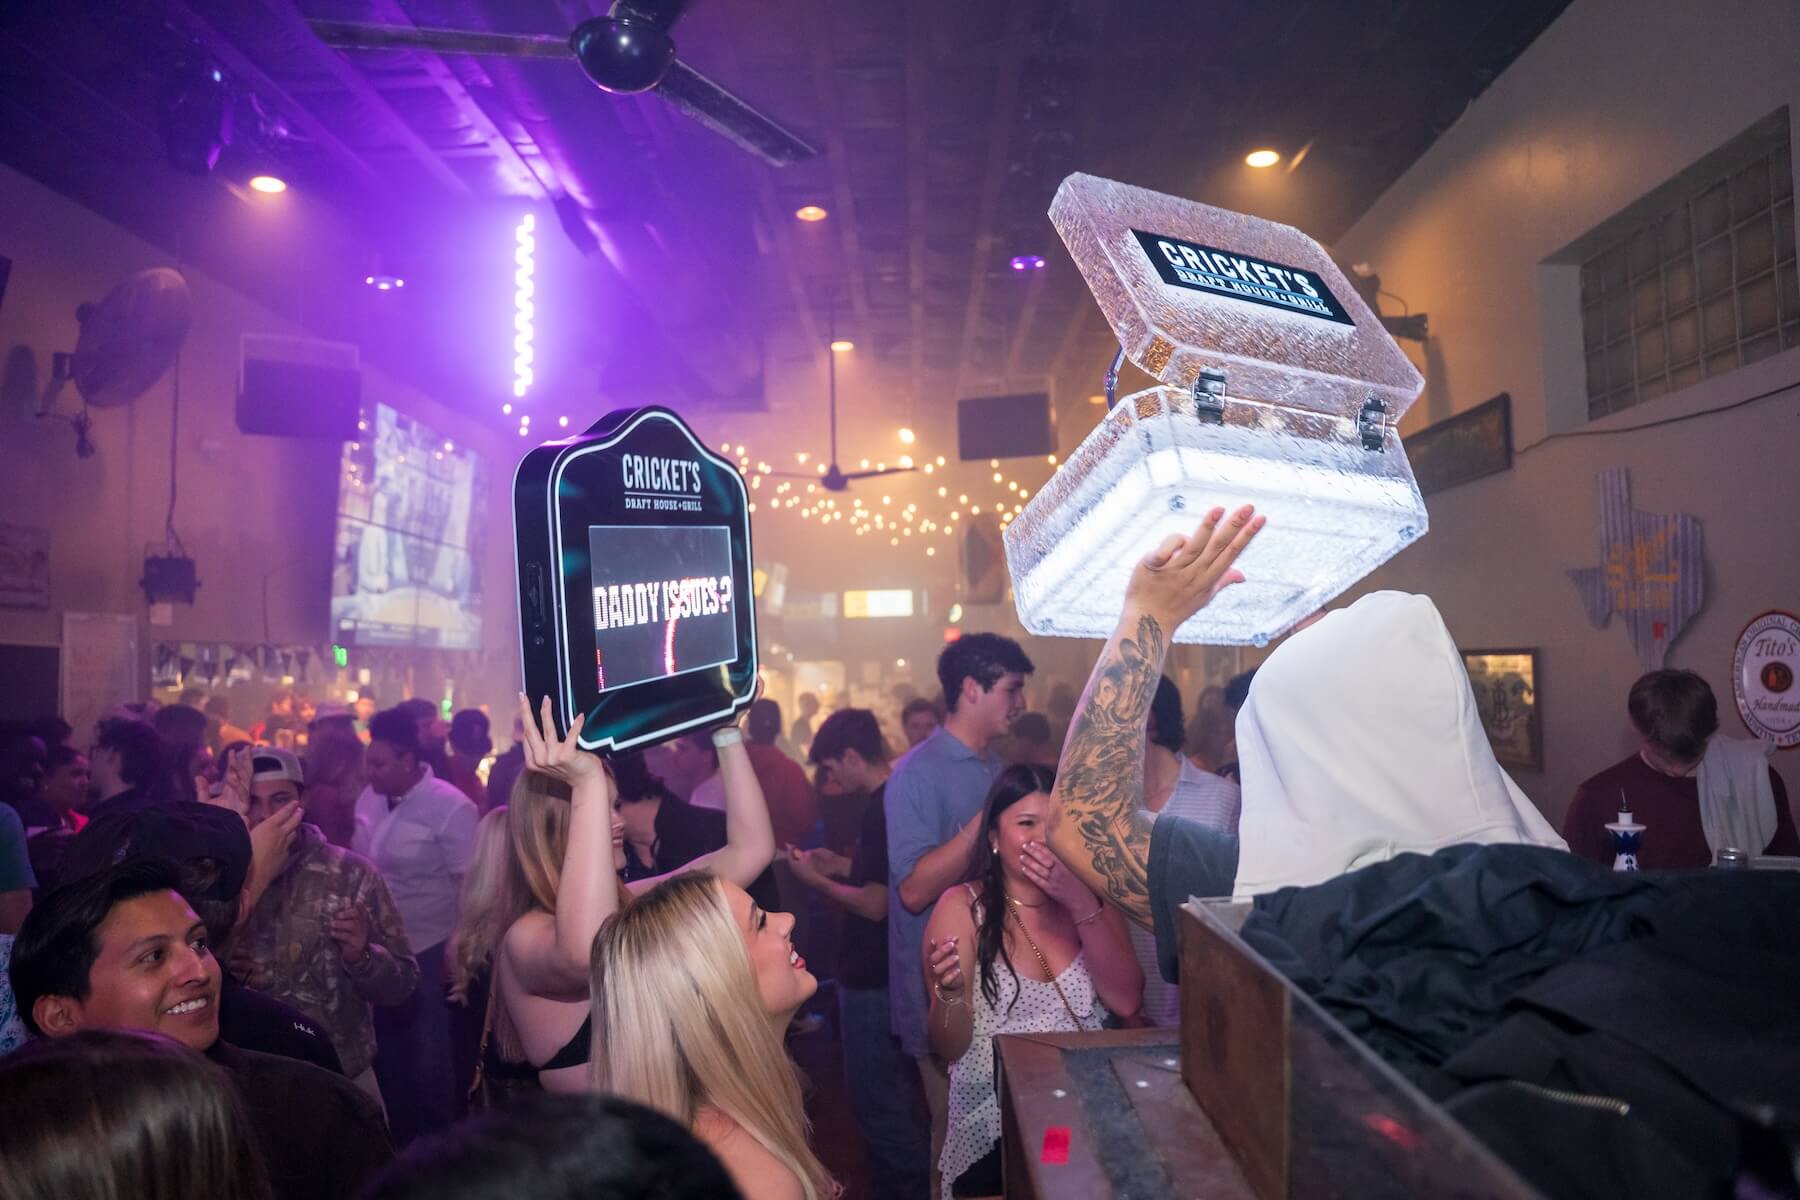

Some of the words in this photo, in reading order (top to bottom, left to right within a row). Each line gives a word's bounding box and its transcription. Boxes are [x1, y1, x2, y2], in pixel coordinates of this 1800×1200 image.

[1157, 240, 1318, 298] CRICKET'S
[622, 453, 701, 493] CRICKET'S
[625, 498, 651, 509] DRAFT
[594, 581, 659, 630] DADDY
[662, 575, 732, 620] ISSUES?
[1755, 636, 1795, 656] Tito's
[1753, 696, 1800, 712] Handmad
